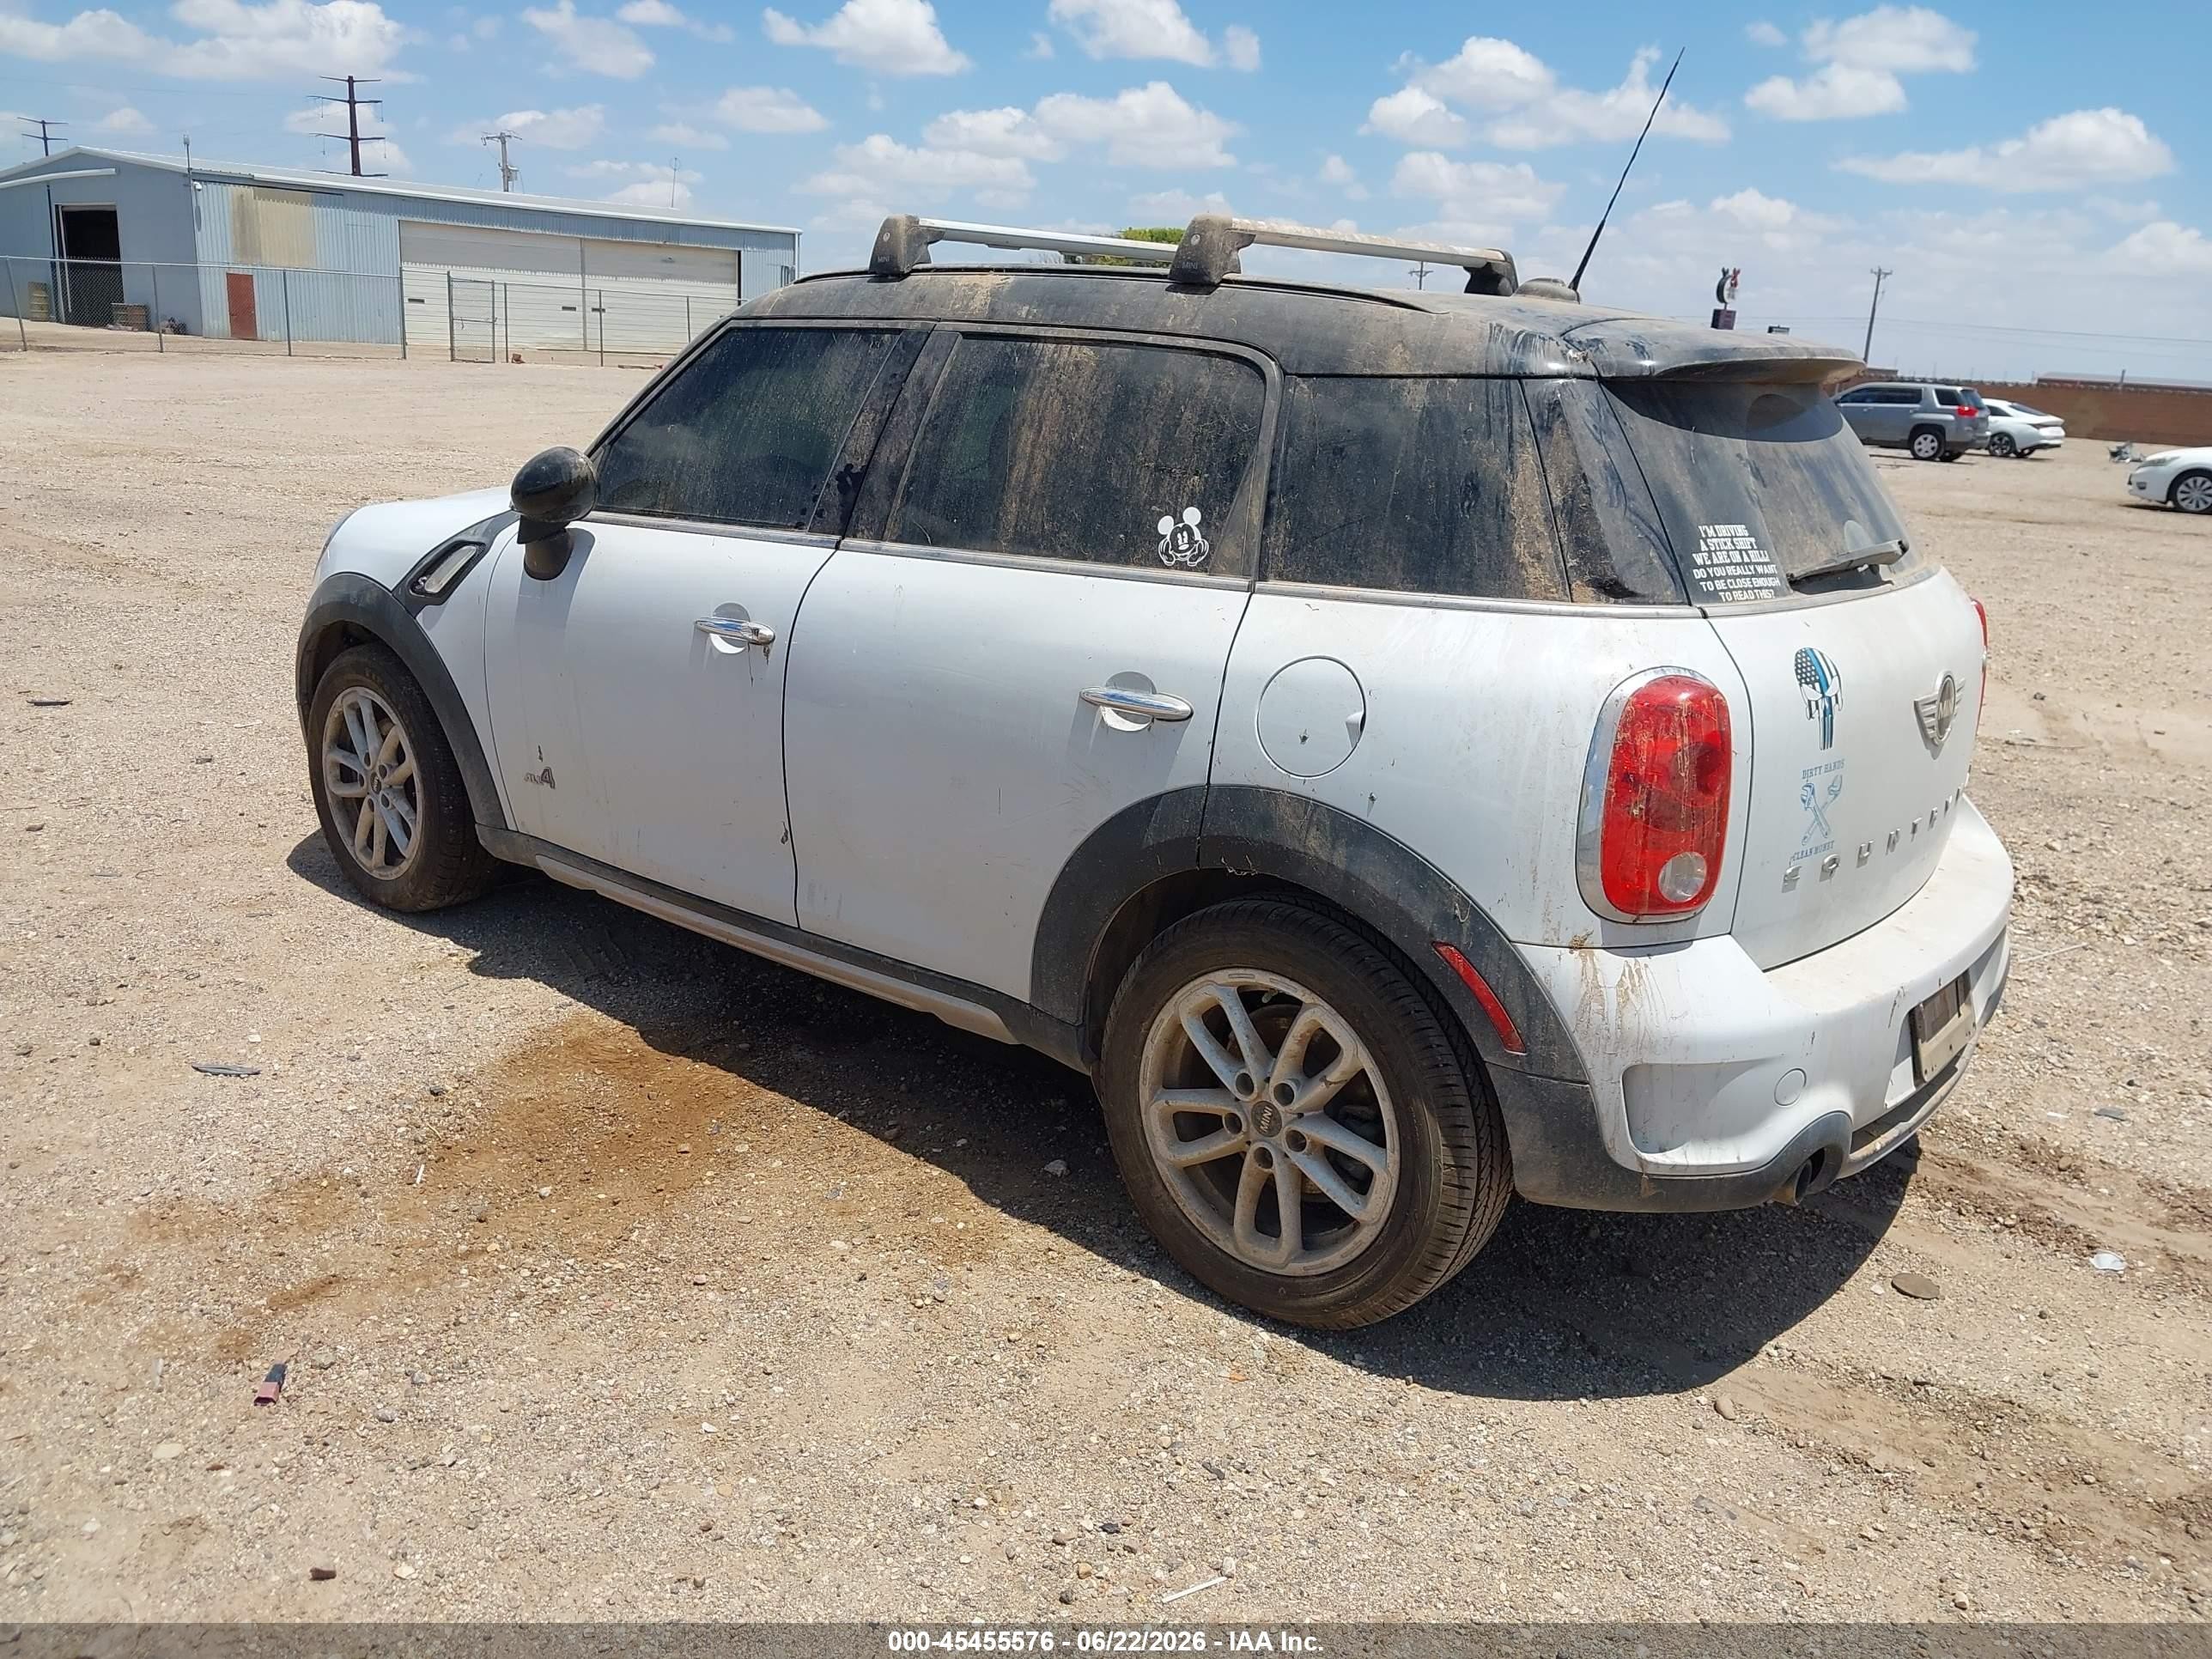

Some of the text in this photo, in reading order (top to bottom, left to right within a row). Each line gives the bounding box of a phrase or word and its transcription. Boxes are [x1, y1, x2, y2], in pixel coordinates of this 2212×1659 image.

[1698, 524, 1749, 538] I'M DRIVING
[1699, 537, 1758, 551] A STICK SHIFT
[1692, 552, 1711, 566] WE
[1711, 550, 1730, 564] ARE
[1729, 550, 1742, 563] ON
[1741, 550, 1751, 562] A
[1692, 564, 1778, 580] DO YOU REALLY WANT
[1699, 577, 1781, 592] TO BE CLOSE ENOUGH
[1718, 588, 1776, 602] TO READ THIS?
[1259, 1105, 1273, 1133] MINI
